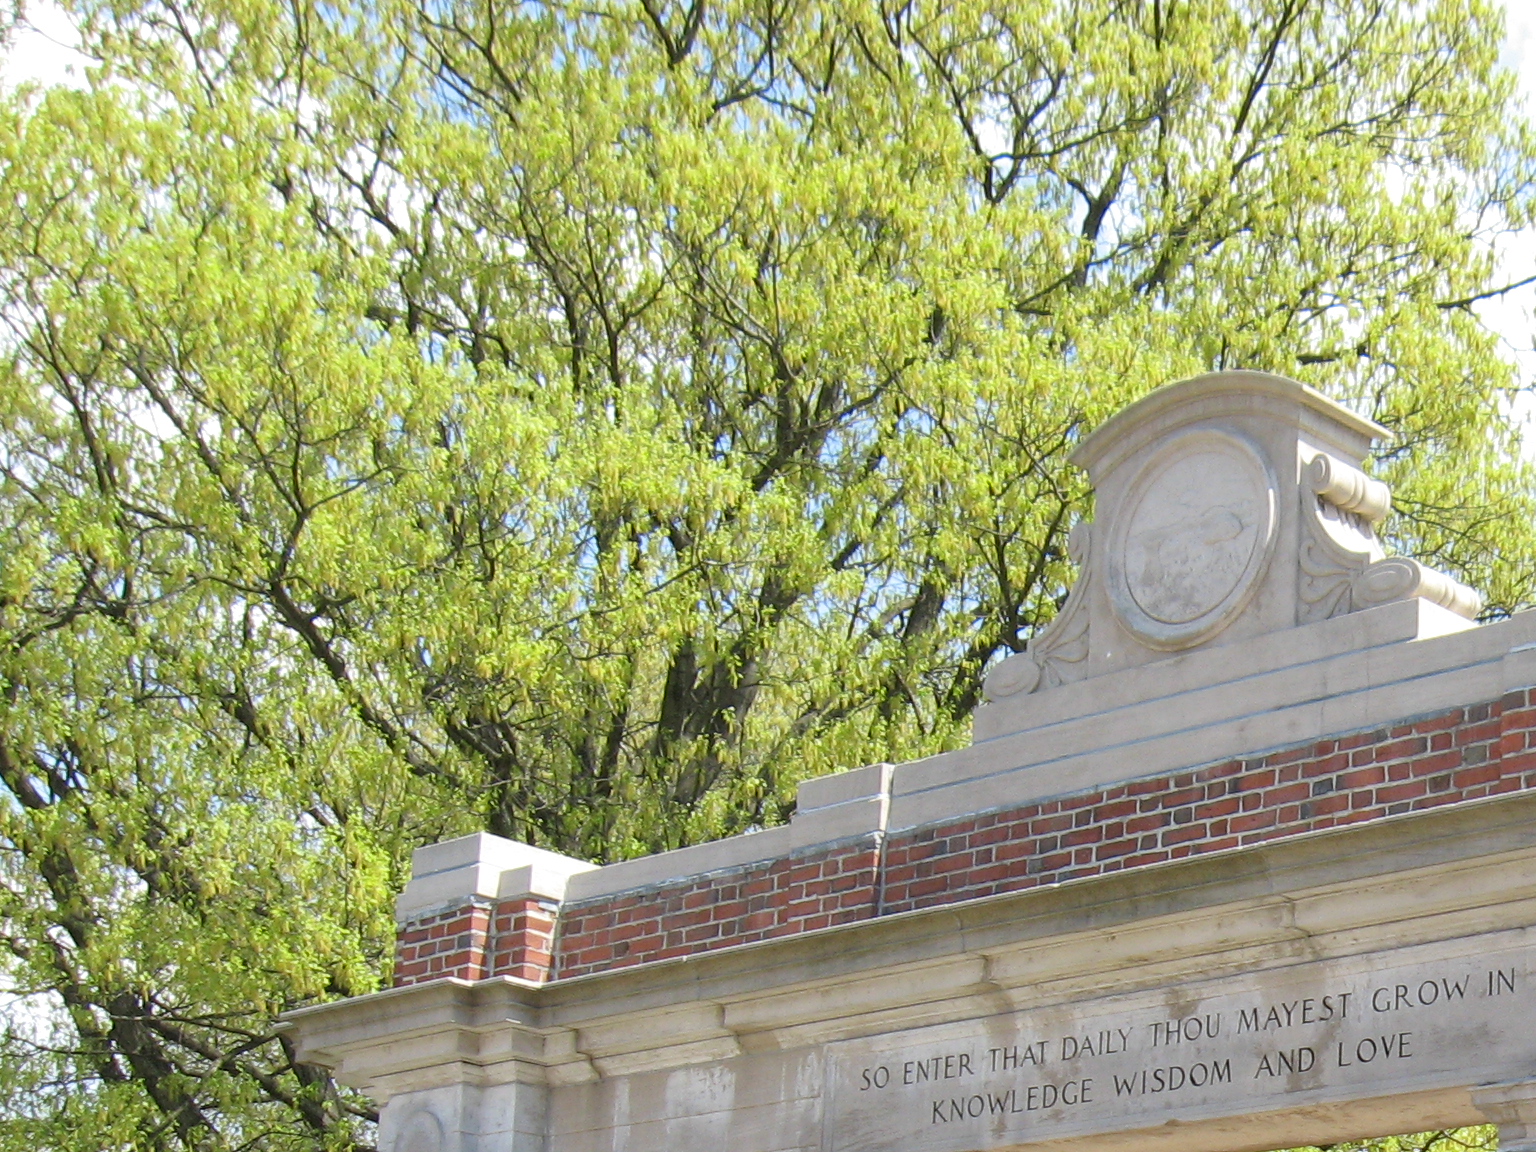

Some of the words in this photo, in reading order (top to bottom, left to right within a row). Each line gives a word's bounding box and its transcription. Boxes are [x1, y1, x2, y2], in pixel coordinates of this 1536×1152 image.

[860, 1065, 890, 1091] SO
[903, 1053, 975, 1085] ENTER
[989, 1040, 1049, 1072] THAT
[1061, 1027, 1133, 1061] DAILY
[1149, 1013, 1221, 1047] THOU
[1237, 992, 1352, 1035] MAYEST
[1371, 974, 1470, 1013] GROW
[1487, 967, 1516, 996] IN
[931, 1078, 1093, 1124] KNOWLEDGE
[1113, 1058, 1232, 1097] WISDOM
[1254, 1046, 1316, 1080] AND
[1337, 1032, 1413, 1067] LOVE
